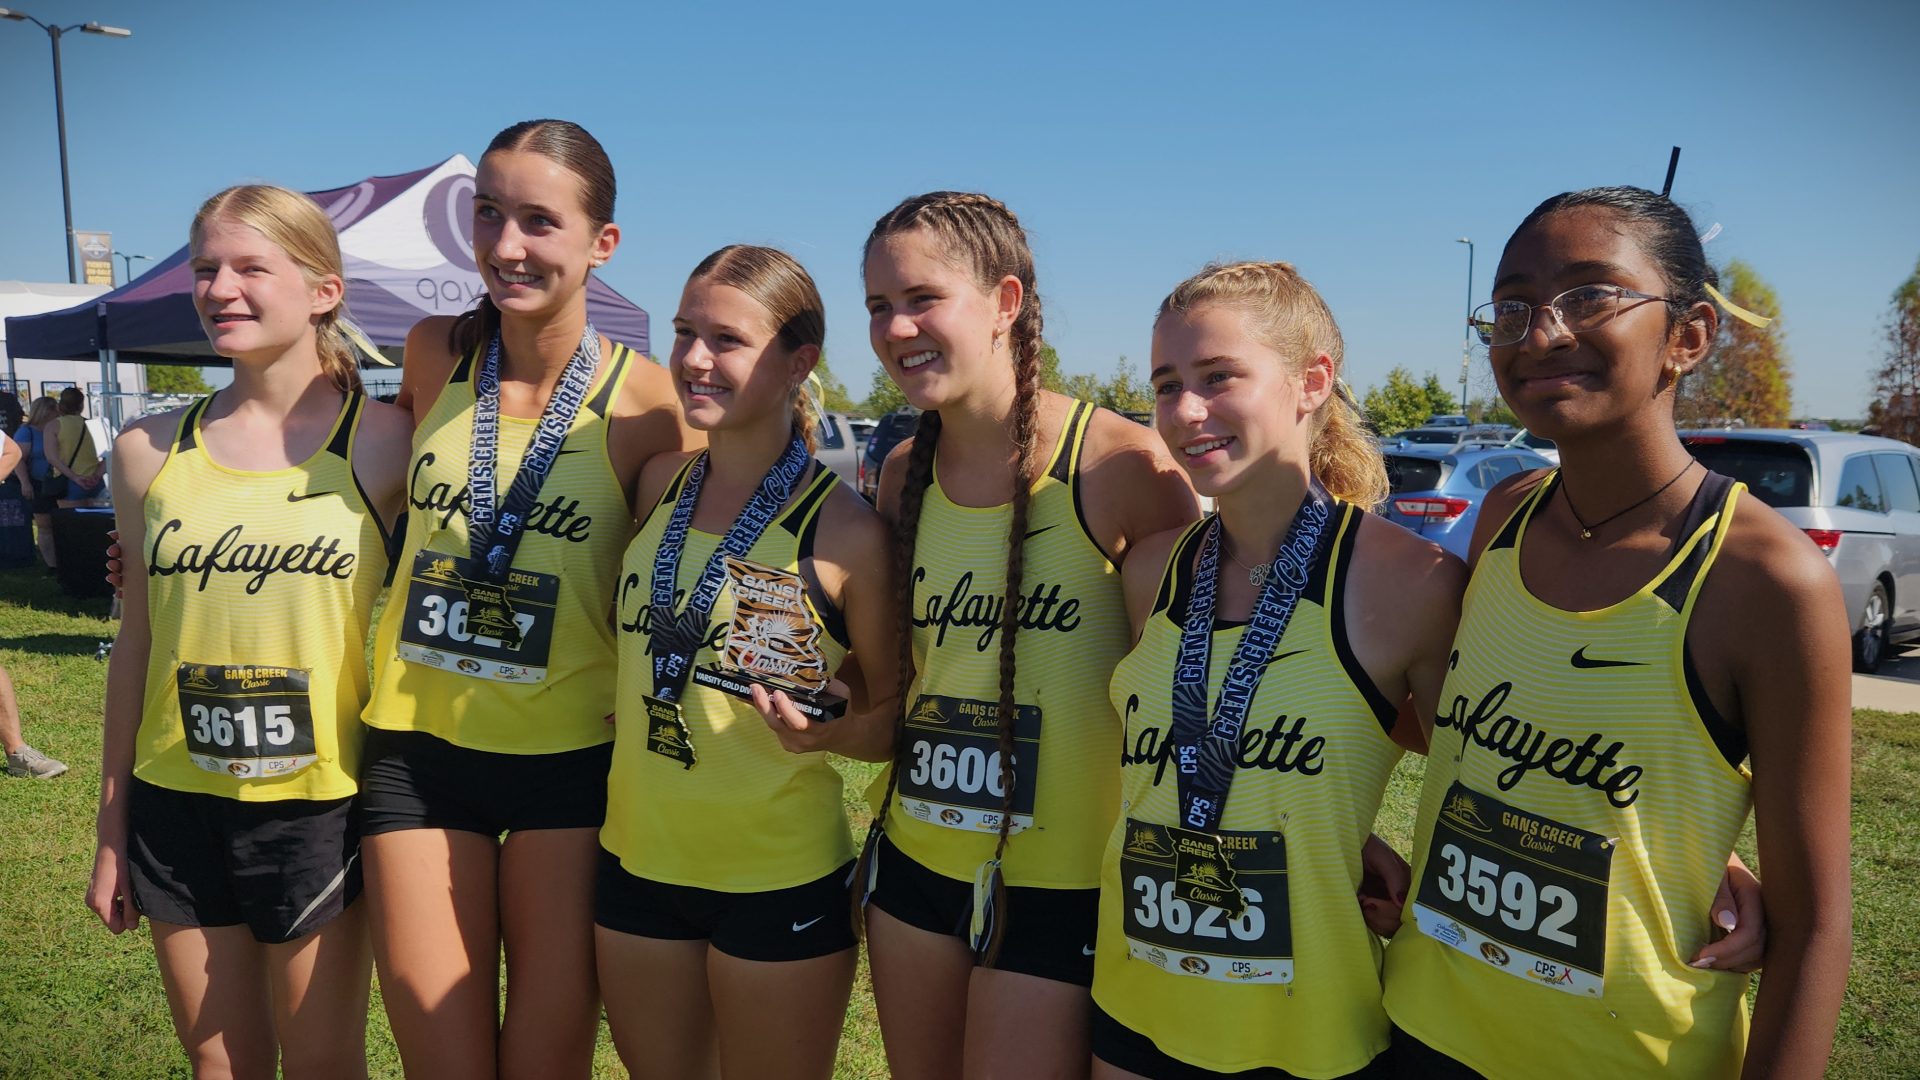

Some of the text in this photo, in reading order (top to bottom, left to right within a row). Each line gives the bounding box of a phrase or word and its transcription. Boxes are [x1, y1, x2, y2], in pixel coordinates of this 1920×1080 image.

[416, 277, 484, 310] qav
[526, 419, 568, 475] GANS
[554, 357, 594, 425] CREEK
[473, 399, 497, 462] CREEK
[409, 452, 592, 543] Lafette
[472, 465, 494, 524] GANS
[498, 512, 518, 535] CPS
[665, 487, 698, 544] CREEK
[725, 495, 777, 556] CREEK
[149, 519, 356, 595] Lafayette
[508, 572, 540, 586] CREEK
[653, 548, 679, 608] GANS
[742, 575, 796, 598] GANS
[1191, 541, 1219, 614] CREEK
[471, 594, 501, 604] CREEK
[474, 588, 500, 599] GANS
[735, 585, 798, 612] CREEK
[418, 595, 535, 650] 367
[1213, 500, 1329, 742] GANS CREEK Classic
[1178, 616, 1210, 684] GANS
[499, 665, 515, 675] CPS
[666, 653, 683, 677] CPS
[738, 648, 799, 676] Classic
[224, 668, 289, 680] GANS CREEK
[241, 679, 271, 690] Classic
[696, 671, 722, 686] VARSITY
[721, 680, 740, 692] GOLD
[650, 709, 678, 724] CREEK
[652, 704, 676, 717] GANS
[791, 700, 823, 717] UNNER UP
[959, 702, 1020, 720] GANS CRK
[190, 704, 295, 747] 3615
[657, 743, 681, 757] Classic
[1121, 693, 1325, 787] Lafette
[268, 761, 285, 770] CPS
[910, 740, 1017, 798] 3606
[1180, 745, 1198, 774] CPS
[982, 814, 999, 825] CPS
[1187, 796, 1210, 828] CPS
[1502, 811, 1586, 850] GANS CREEK
[1178, 846, 1217, 860] CREEK
[1181, 838, 1215, 852] GANS
[1221, 836, 1258, 850] CREEK
[1520, 832, 1557, 854] Classic
[1189, 887, 1223, 902] Classic
[1438, 843, 1577, 948] 3592
[1231, 961, 1251, 973] CPS
[1534, 960, 1557, 978] CPS
